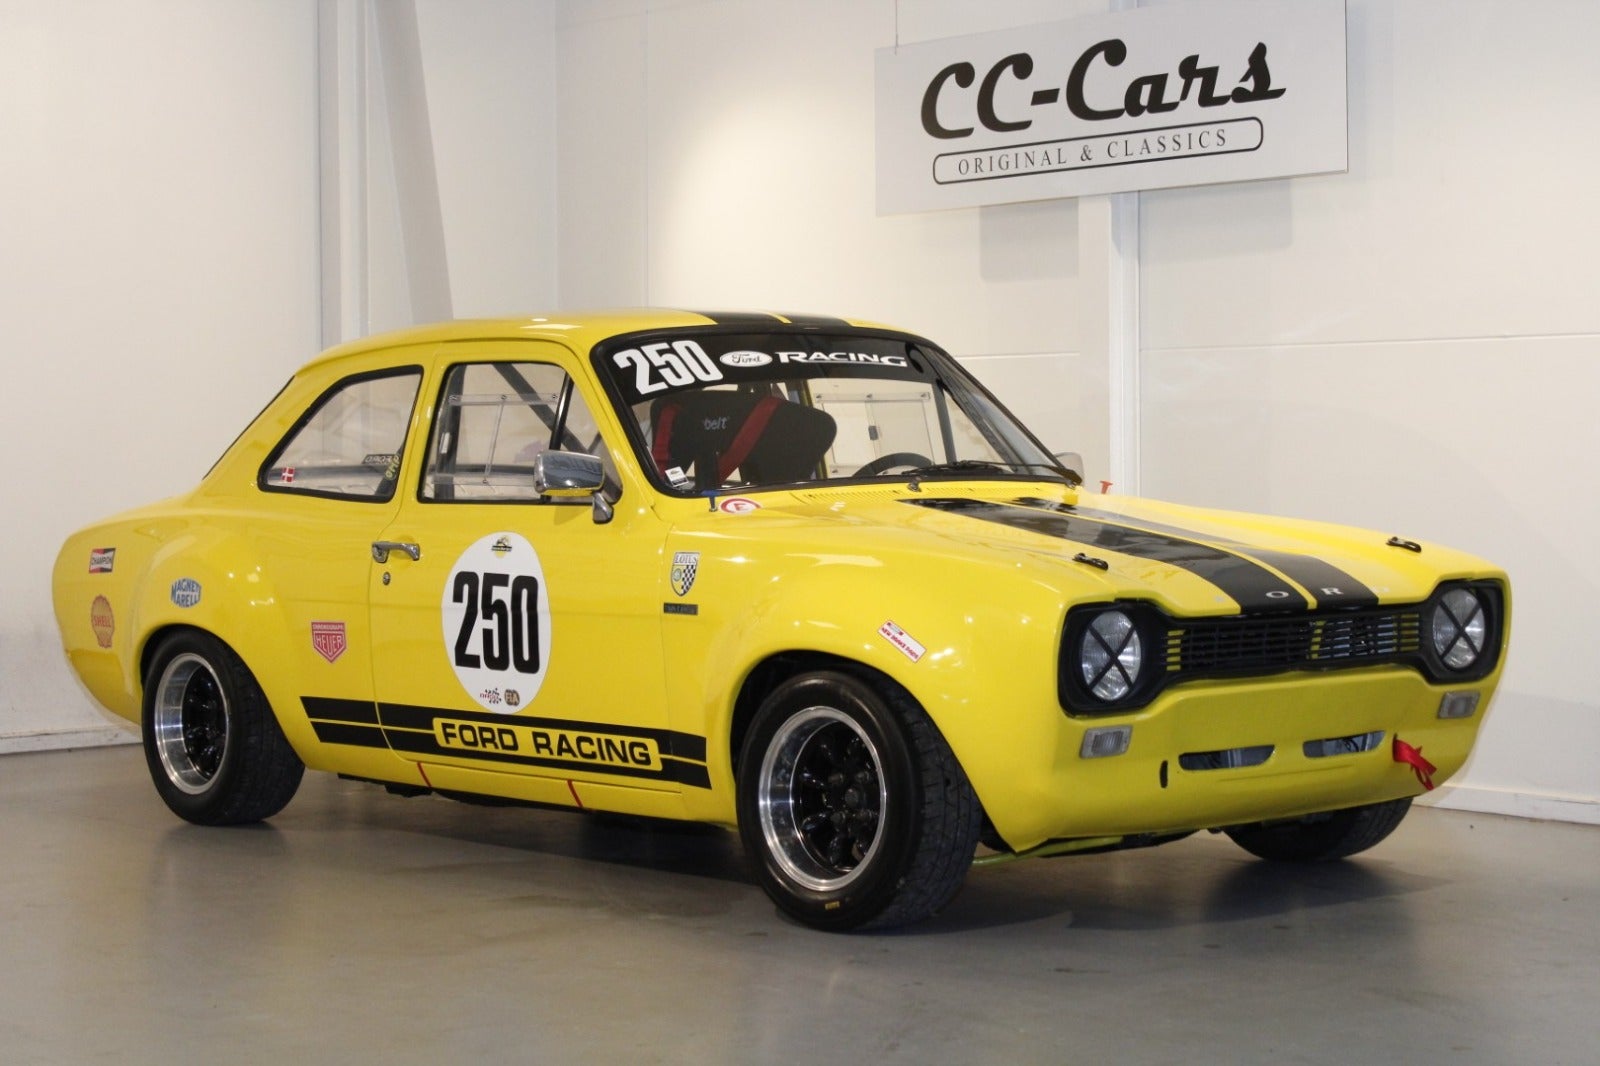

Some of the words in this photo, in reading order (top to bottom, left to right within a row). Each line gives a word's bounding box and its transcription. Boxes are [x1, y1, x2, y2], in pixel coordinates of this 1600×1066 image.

[921, 38, 1287, 140] CC-Cars
[958, 148, 1067, 175] ORIGINAL
[1080, 145, 1093, 161] &
[1107, 128, 1226, 158] CLASSICS
[612, 340, 724, 395] 250
[775, 351, 908, 367] RACING
[674, 554, 697, 564] LOTUS
[93, 615, 112, 628] SHELL
[452, 571, 540, 674] 250
[314, 633, 343, 656] HEUER
[441, 722, 519, 751] FORD
[531, 731, 651, 766] RACING
